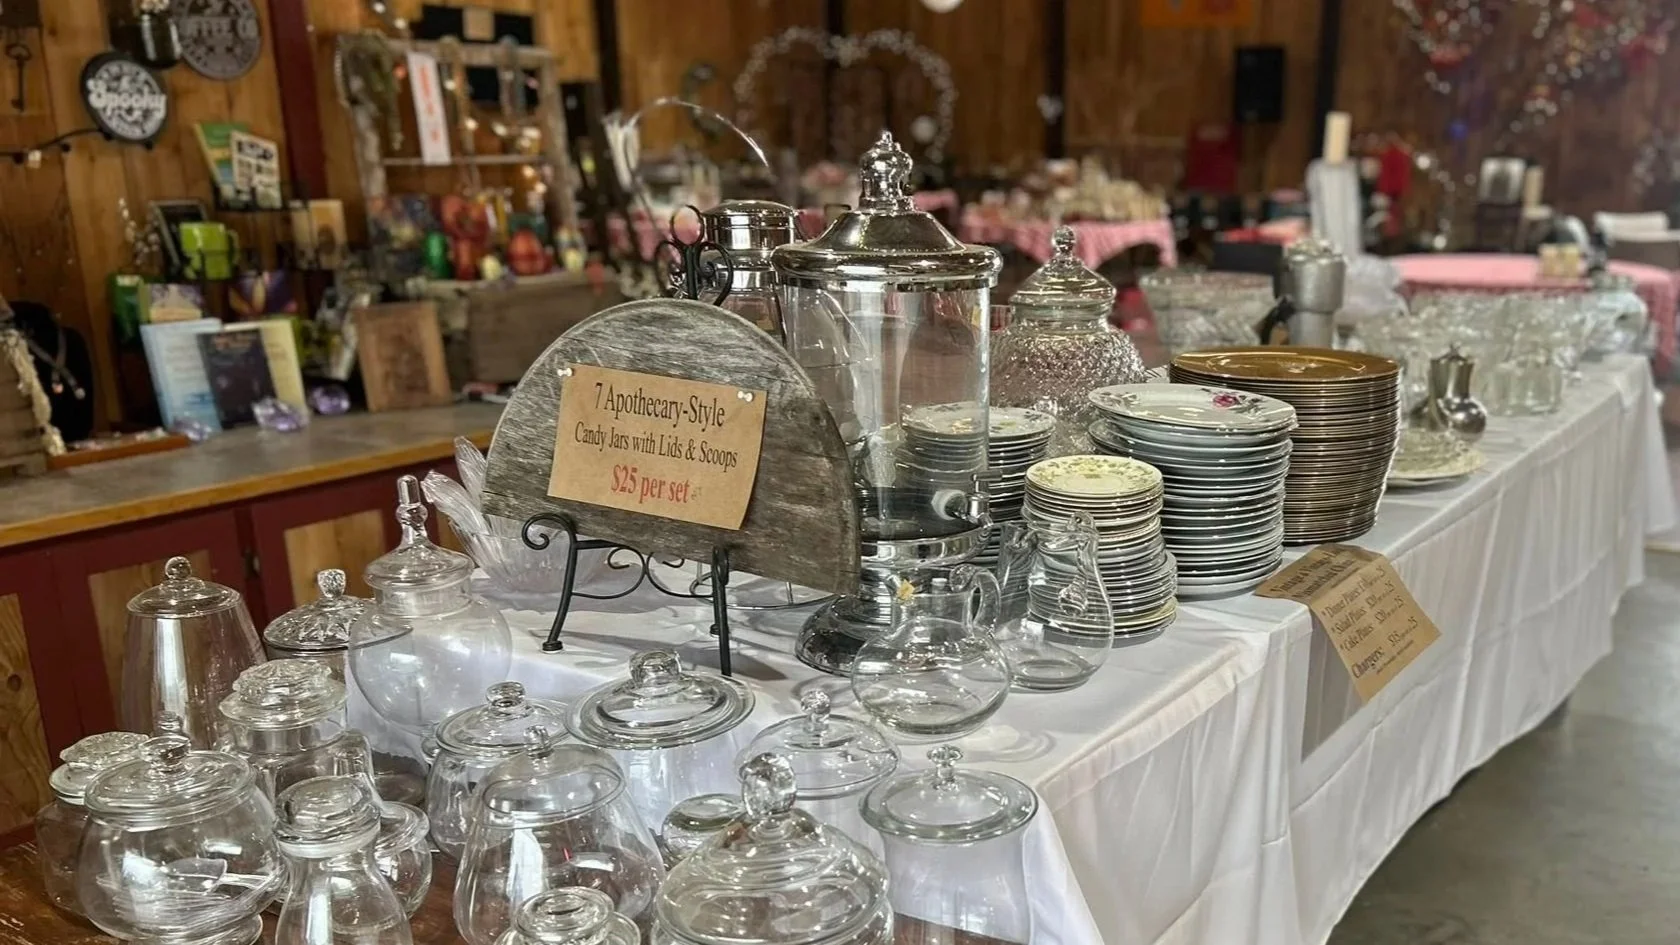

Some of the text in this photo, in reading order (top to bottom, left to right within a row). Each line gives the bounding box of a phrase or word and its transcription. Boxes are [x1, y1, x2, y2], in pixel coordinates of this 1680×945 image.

[595, 382, 726, 432] 7 Apothecary-Style
[575, 421, 738, 473] Candy Jars with Lids & Scoops
[611, 464, 691, 504] $25 per set
